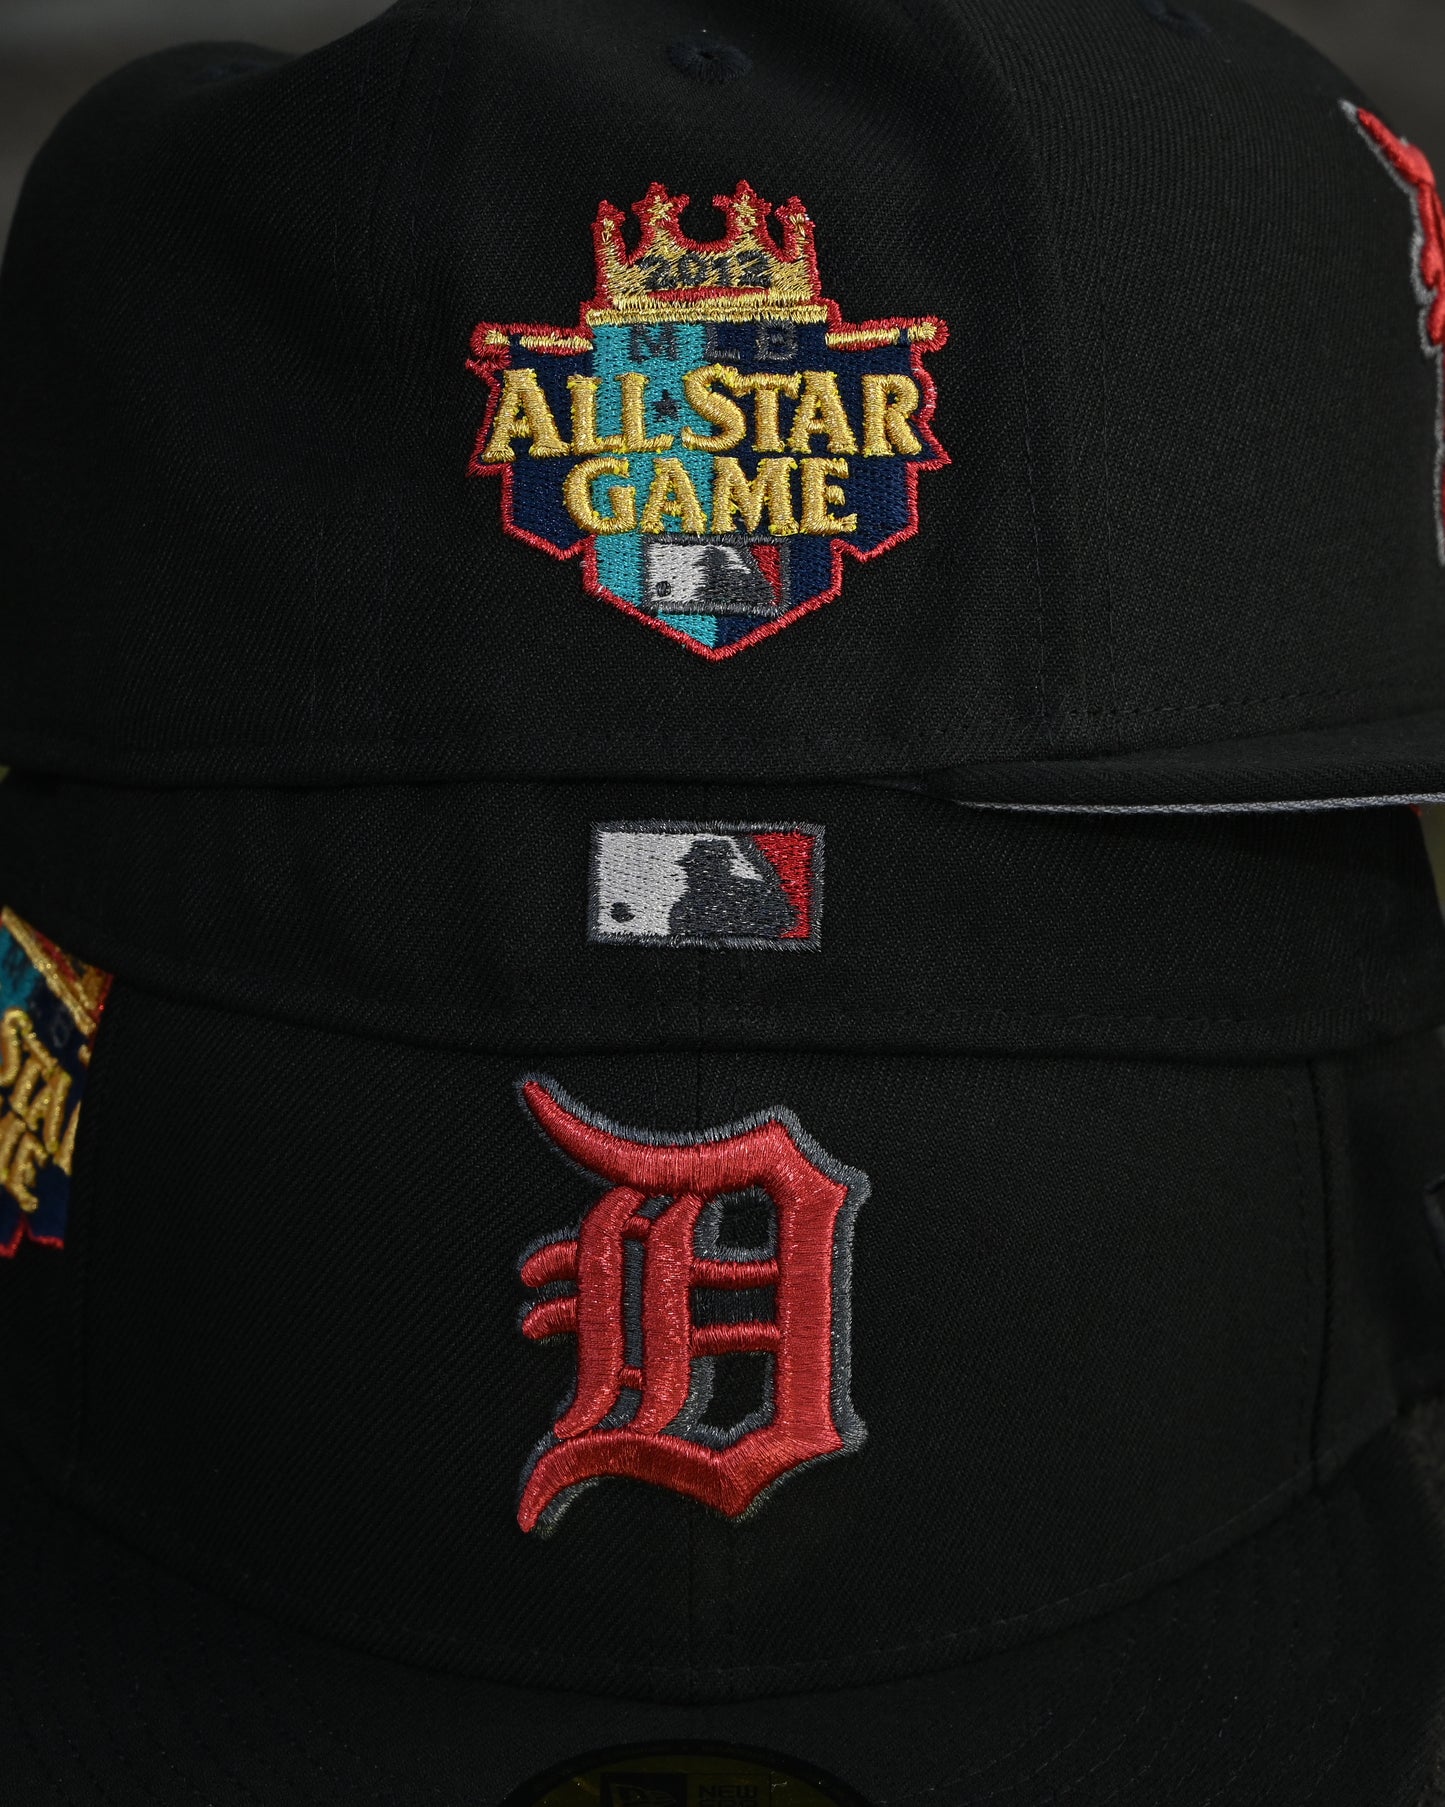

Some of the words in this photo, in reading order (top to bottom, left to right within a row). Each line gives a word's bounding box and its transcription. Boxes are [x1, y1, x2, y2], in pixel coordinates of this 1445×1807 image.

[640, 250, 772, 290] 2012
[628, 322, 799, 362] MLB
[481, 367, 674, 462] ALL
[682, 364, 922, 458] STAR
[563, 456, 858, 537] GAME
[698, 1784, 759, 1798] NEW
